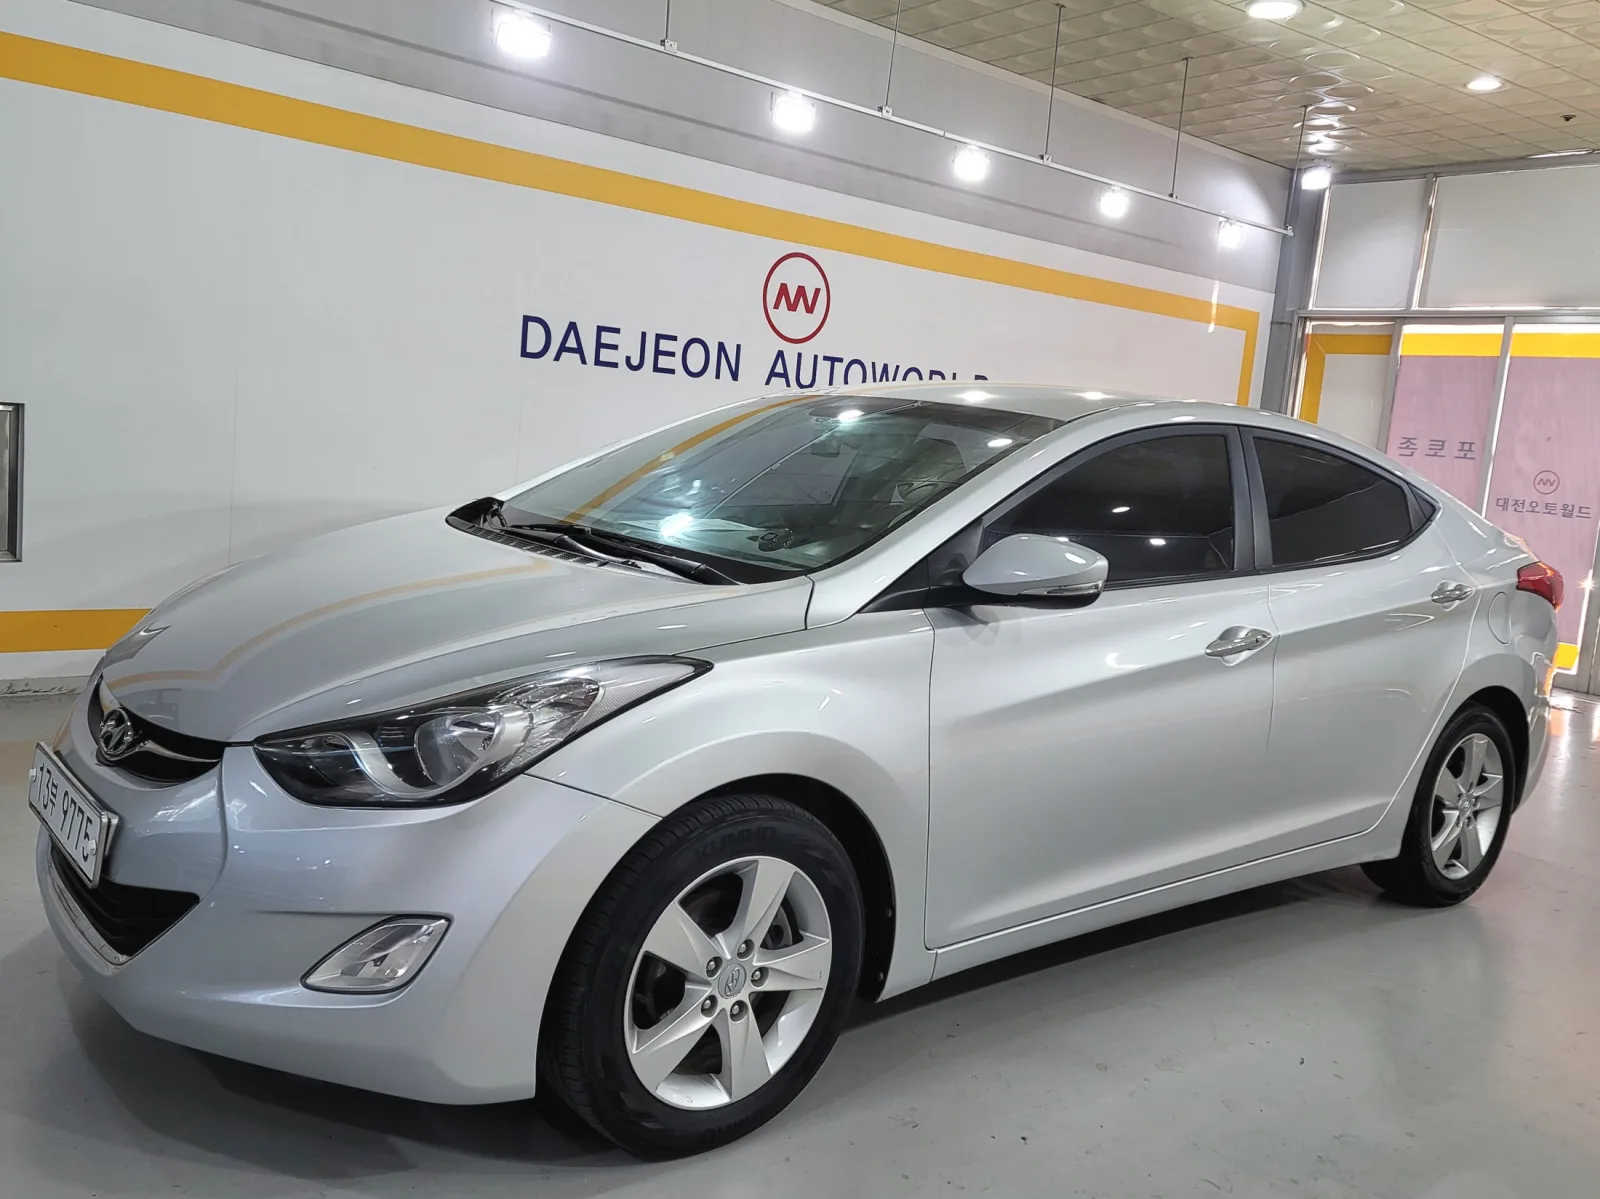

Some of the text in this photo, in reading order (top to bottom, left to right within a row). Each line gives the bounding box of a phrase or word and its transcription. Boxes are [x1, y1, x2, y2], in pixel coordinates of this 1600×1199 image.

[520, 314, 741, 382] DAEJEON
[1495, 496, 1593, 520] 대전오토월드
[60, 789, 93, 863] 9775
